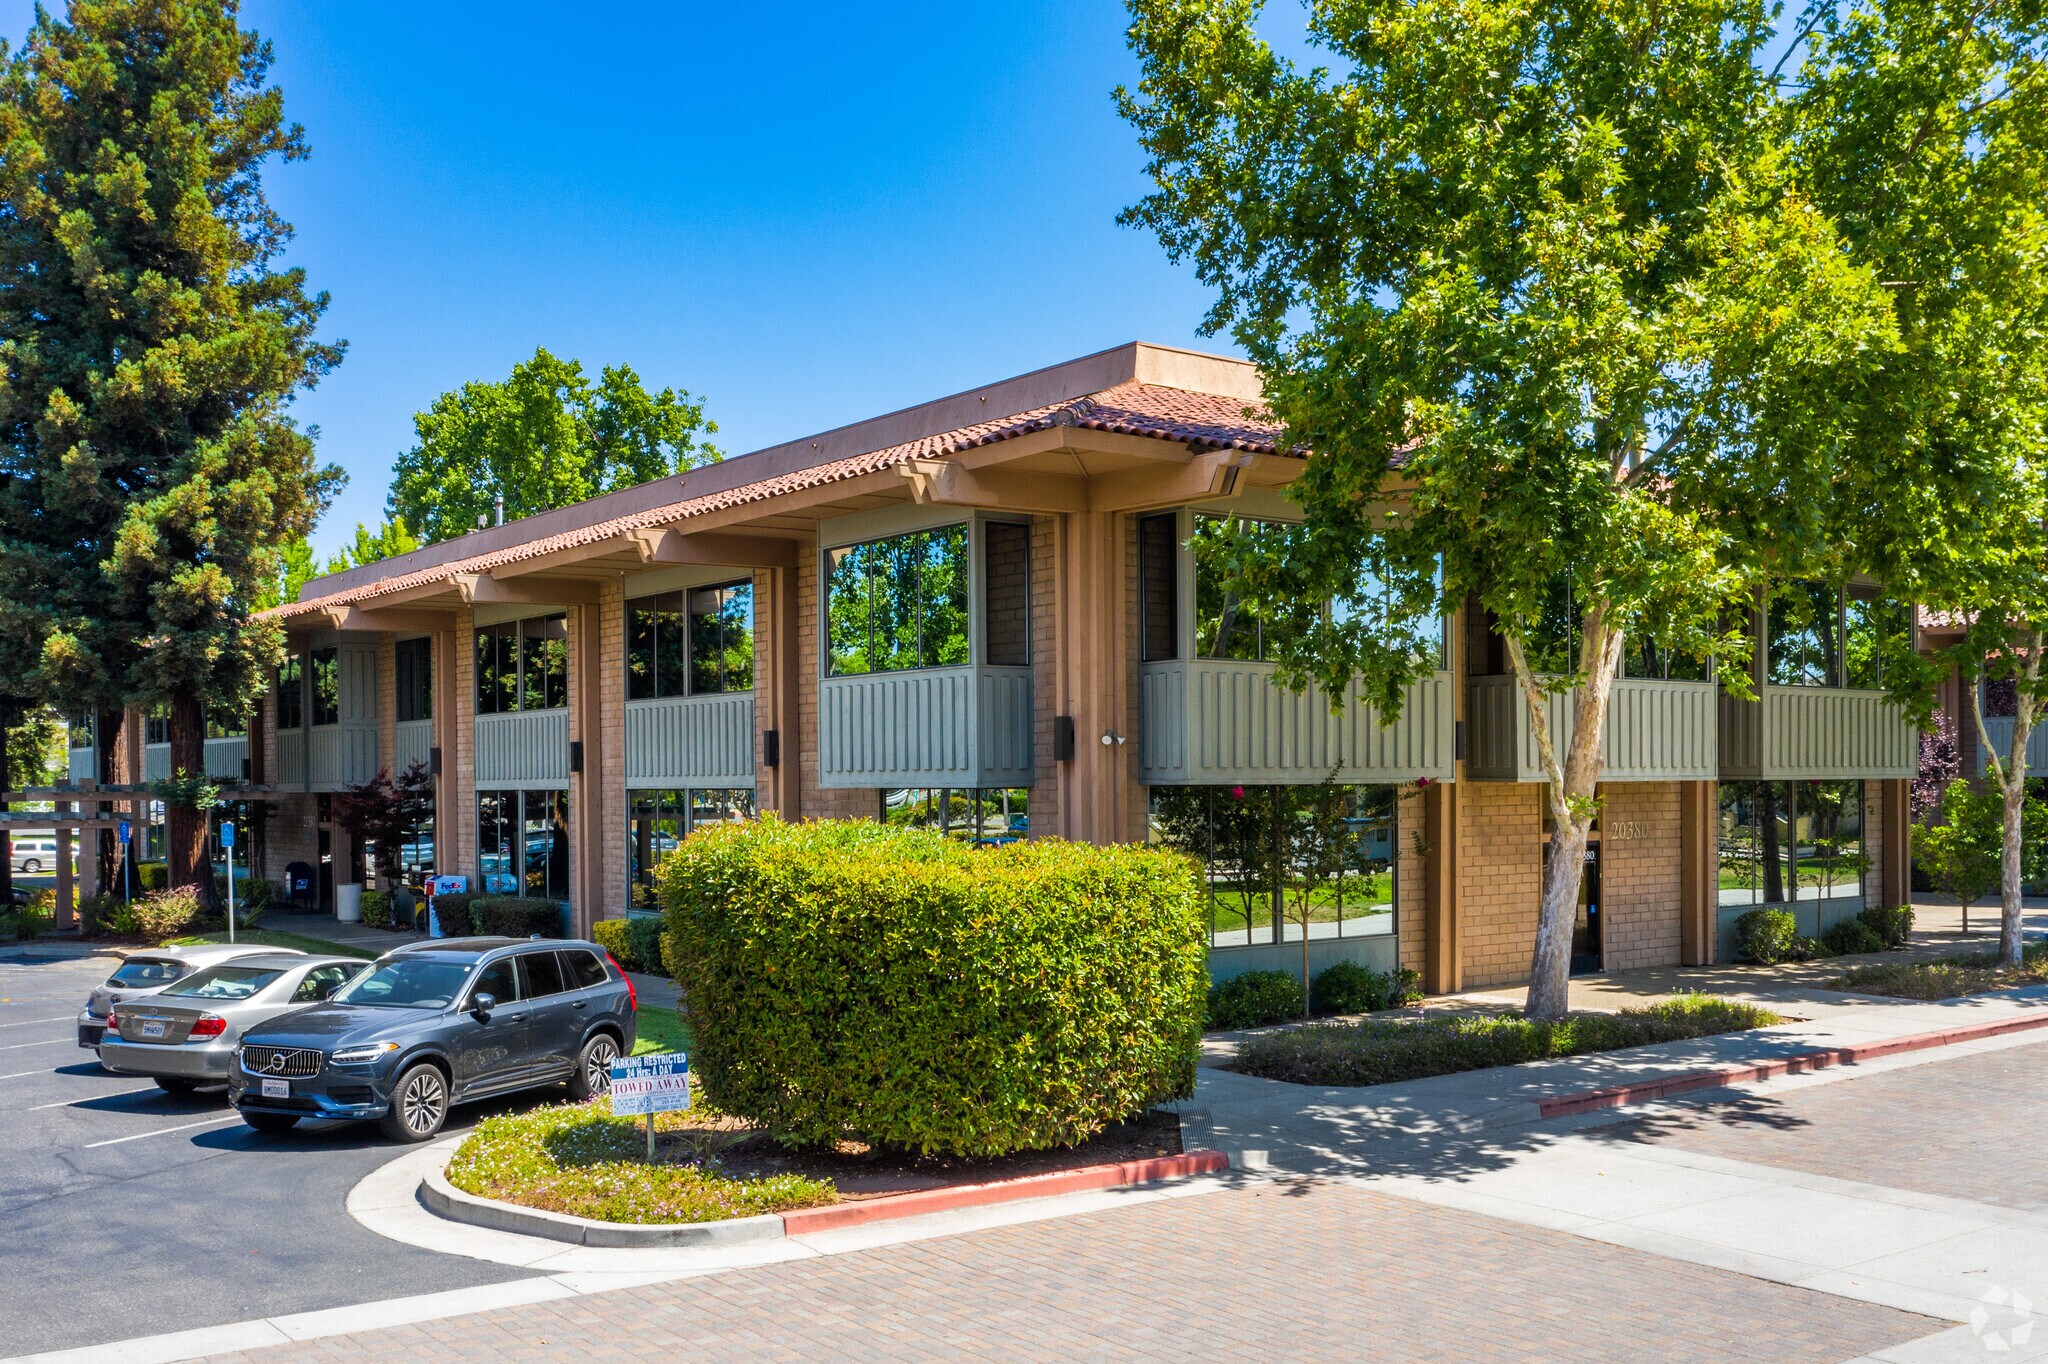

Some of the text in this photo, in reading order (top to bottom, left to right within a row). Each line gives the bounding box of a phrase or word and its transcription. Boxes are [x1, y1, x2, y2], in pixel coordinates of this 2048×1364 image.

[1611, 821, 1648, 839] 20380
[611, 1053, 686, 1070] PARKING RESTRICTED
[626, 1068, 635, 1079] 24
[652, 1065, 658, 1077] A
[658, 1064, 674, 1076] DAY
[614, 1081, 653, 1095] TOWED
[656, 1077, 687, 1090] AWAY
